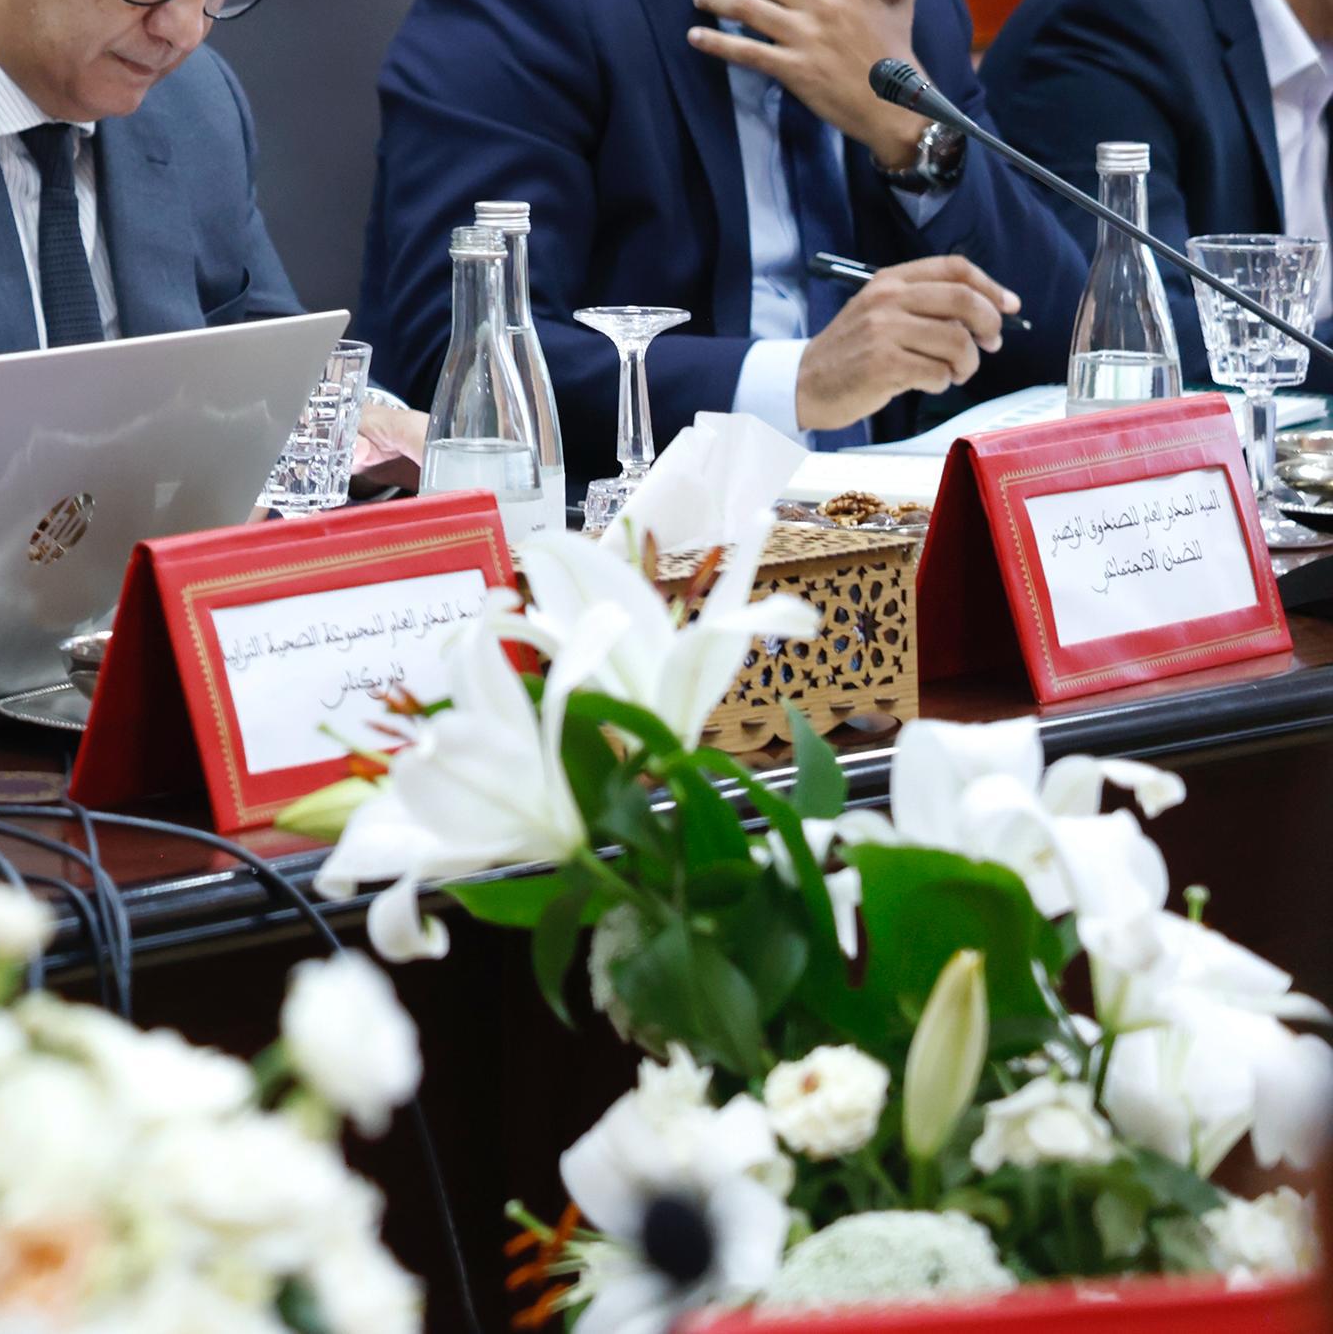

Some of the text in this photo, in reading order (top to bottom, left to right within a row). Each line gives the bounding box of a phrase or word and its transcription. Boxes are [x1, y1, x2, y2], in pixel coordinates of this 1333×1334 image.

[1051, 489, 1221, 558] السيد المدير العام للصندوق الوطني
[1091, 539, 1203, 594] للضمان الاجتماعي
[264, 624, 320, 657] الصحية
[322, 611, 385, 651] للمجموعة
[389, 607, 417, 648] العام
[415, 601, 453, 640] المدير
